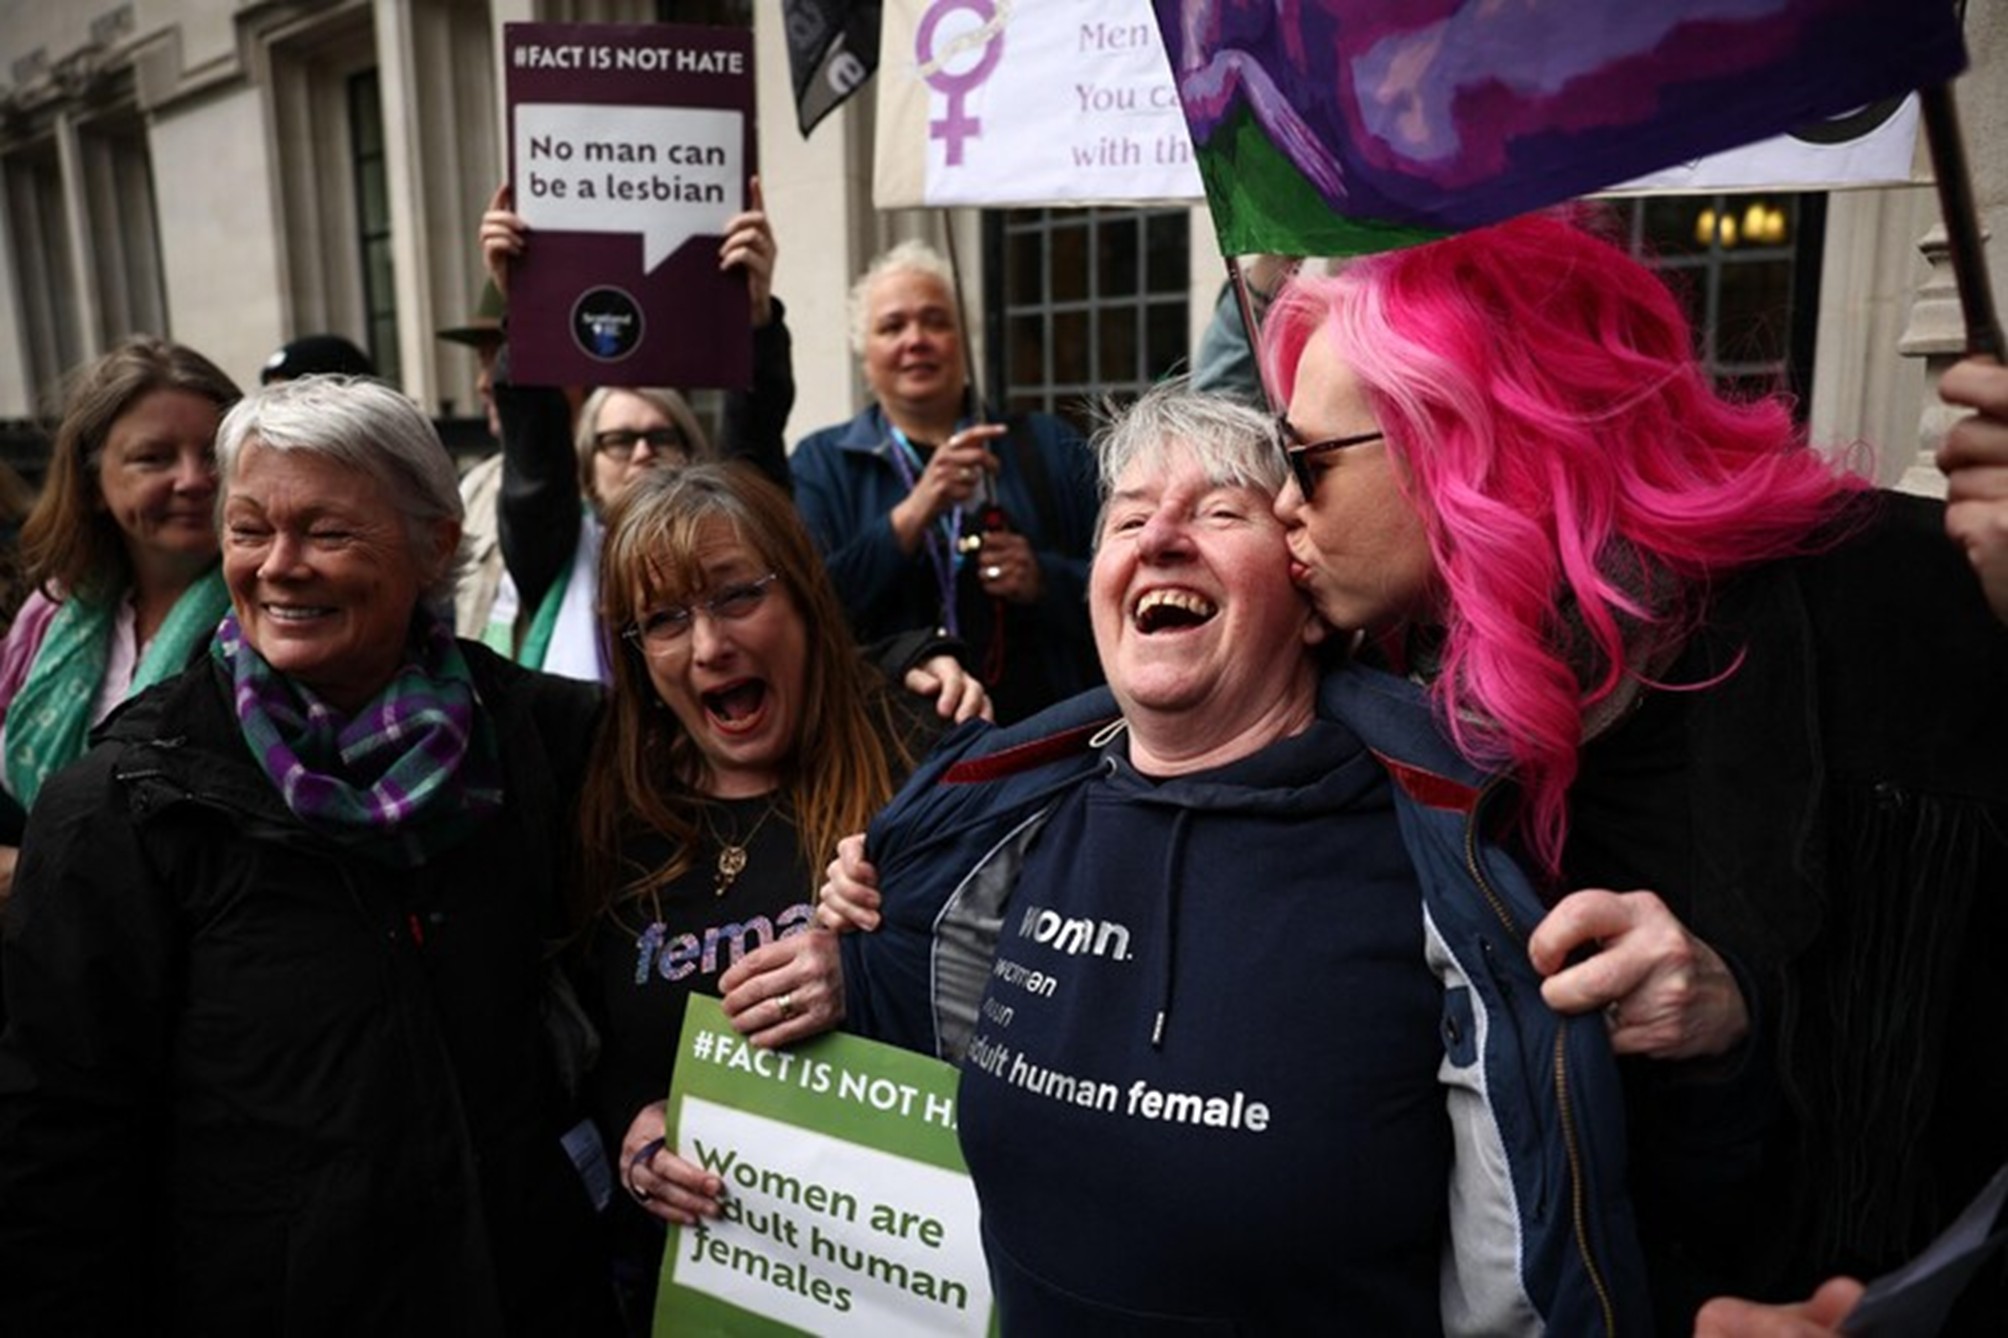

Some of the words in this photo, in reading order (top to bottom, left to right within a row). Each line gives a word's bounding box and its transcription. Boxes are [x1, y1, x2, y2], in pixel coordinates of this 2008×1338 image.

[1078, 22, 1149, 53] Men
[513, 46, 585, 68] #FACT
[589, 48, 611, 68] IS
[616, 49, 671, 70] NOT
[676, 51, 743, 74] HATE
[1074, 83, 1136, 113] You
[529, 136, 574, 162] No
[583, 141, 656, 164] man
[667, 144, 726, 166] can
[1071, 135, 1141, 167] with
[529, 172, 567, 198] be
[577, 178, 596, 200] a
[606, 174, 725, 203] lesbian
[692, 1030, 796, 1082] #FACT
[799, 1059, 833, 1093] IS
[837, 1070, 919, 1117] NOT
[923, 1093, 959, 1129] H
[1008, 1052, 1119, 1113] human
[1127, 1080, 1271, 1132] female
[693, 1138, 859, 1222] Women
[870, 1203, 946, 1249] are
[689, 1224, 853, 1313] females
[720, 1197, 799, 1250] dult
[810, 1227, 968, 1311] human
